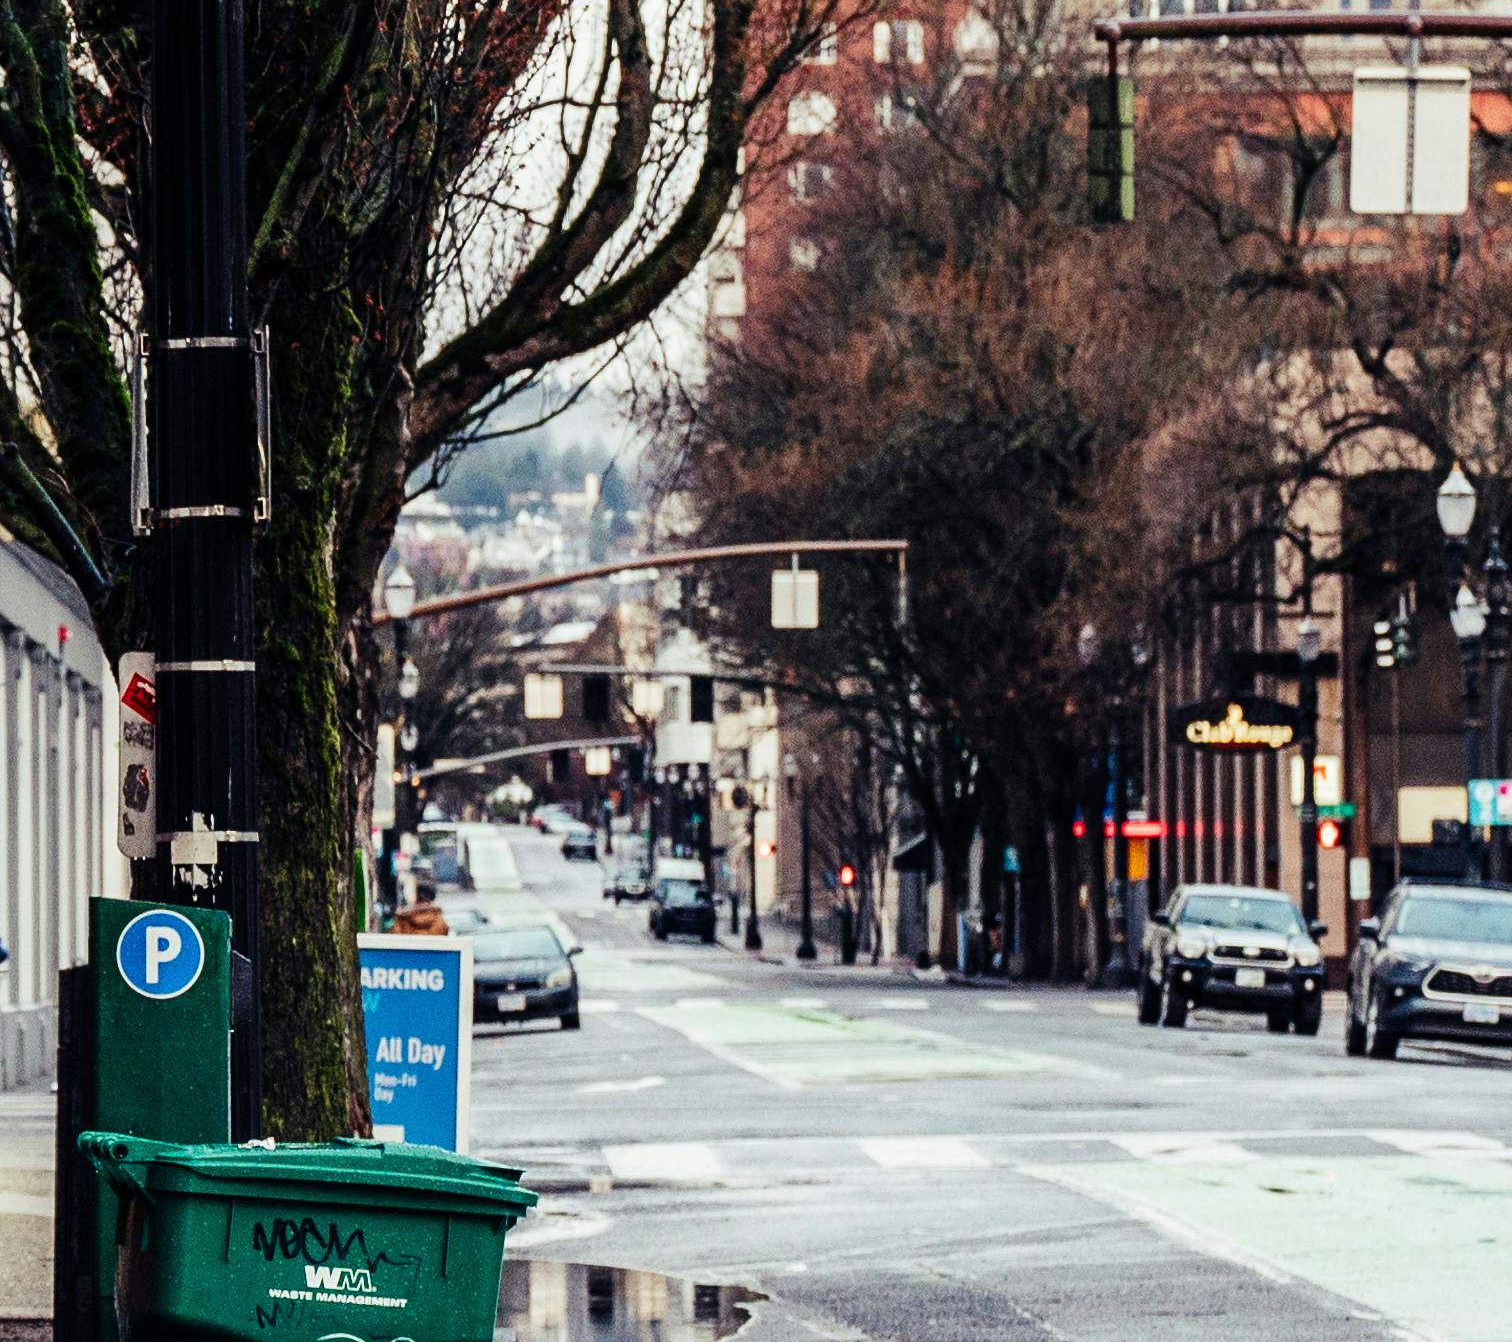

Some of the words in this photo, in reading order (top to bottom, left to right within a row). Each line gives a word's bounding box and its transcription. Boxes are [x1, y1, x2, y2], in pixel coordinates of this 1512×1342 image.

[144, 925, 182, 985] P
[361, 967, 445, 992] ARKING
[376, 1036, 403, 1064] All
[408, 1036, 446, 1071] Day
[268, 1288, 313, 1300] WASTE
[315, 1292, 408, 1308] MANAGEMENT
